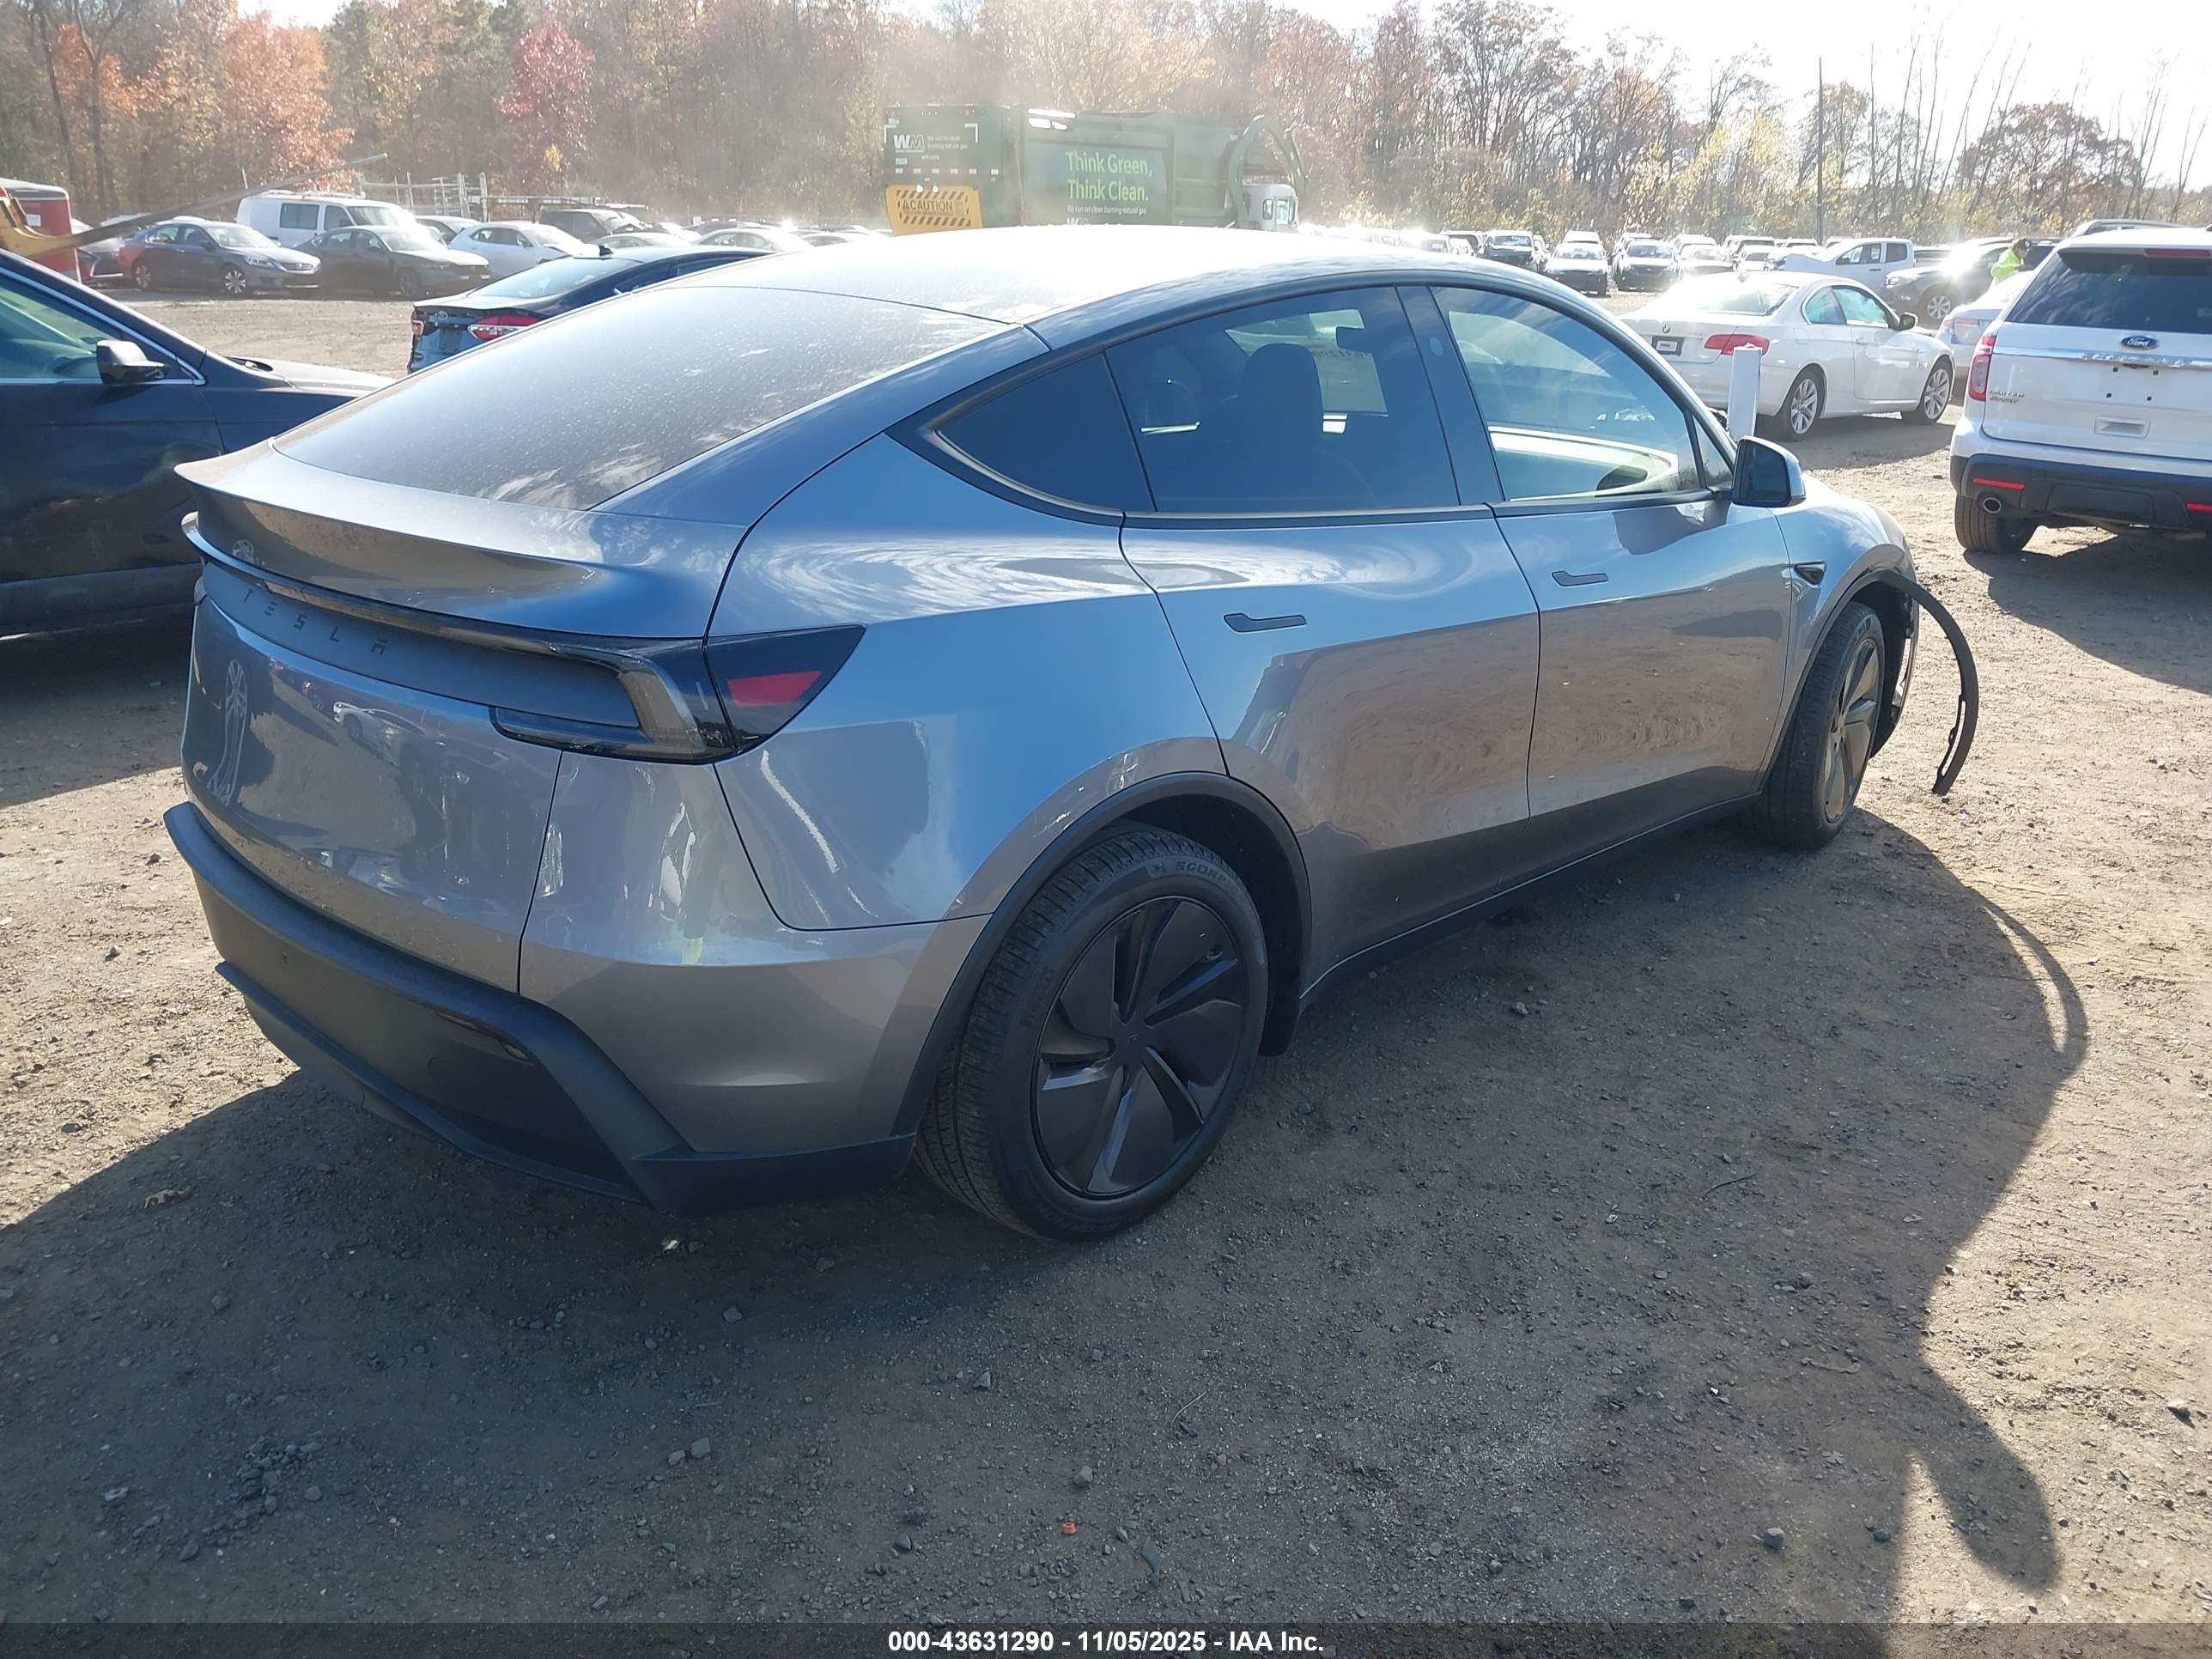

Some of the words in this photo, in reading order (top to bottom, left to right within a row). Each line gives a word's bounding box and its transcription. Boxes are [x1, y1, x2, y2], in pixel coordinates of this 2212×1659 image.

[1065, 151, 1105, 173] Think
[1107, 154, 1153, 178] Green,
[1066, 179, 1106, 199] Think
[1108, 179, 1149, 202] Clean.
[909, 200, 953, 211] CAUTION
[1104, 206, 1121, 216] burning
[2127, 337, 2150, 347] Ford
[242, 588, 390, 655] TESLA
